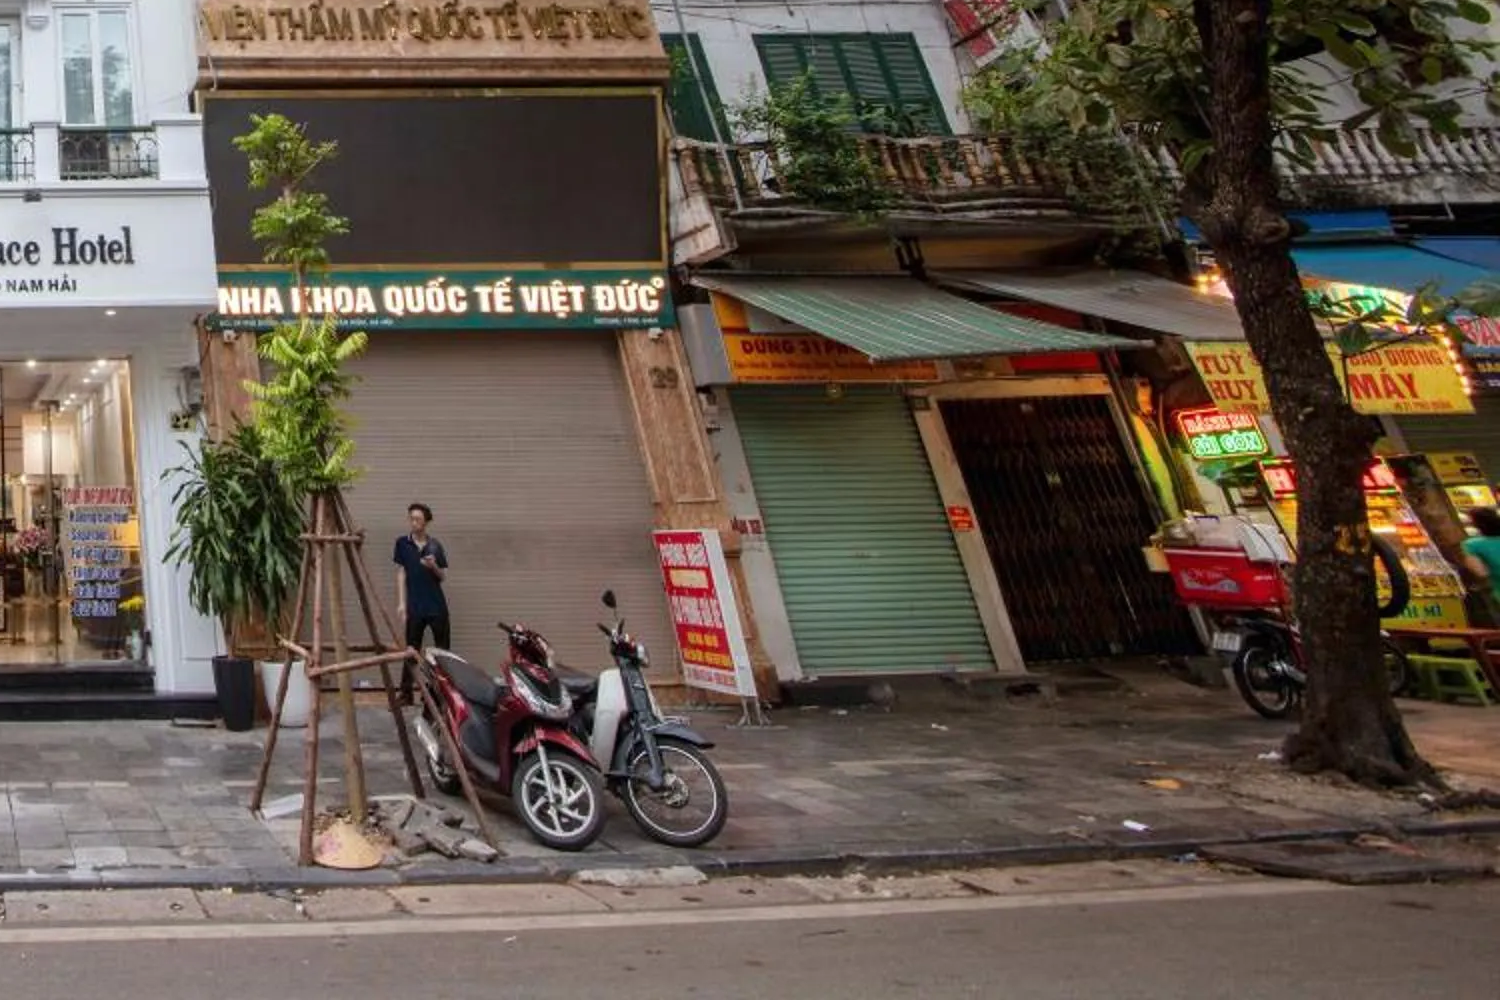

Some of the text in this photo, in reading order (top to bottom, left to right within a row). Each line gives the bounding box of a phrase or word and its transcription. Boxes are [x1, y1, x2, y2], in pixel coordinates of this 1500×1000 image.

[51, 226, 136, 266] Hotel
[6, 279, 45, 293] NAM
[48, 273, 78, 292] HẢI
[218, 276, 661, 318] NHA KHOA QUỐC TẾ VIỆT ĐỨC
[1347, 367, 1420, 399] MÁY
